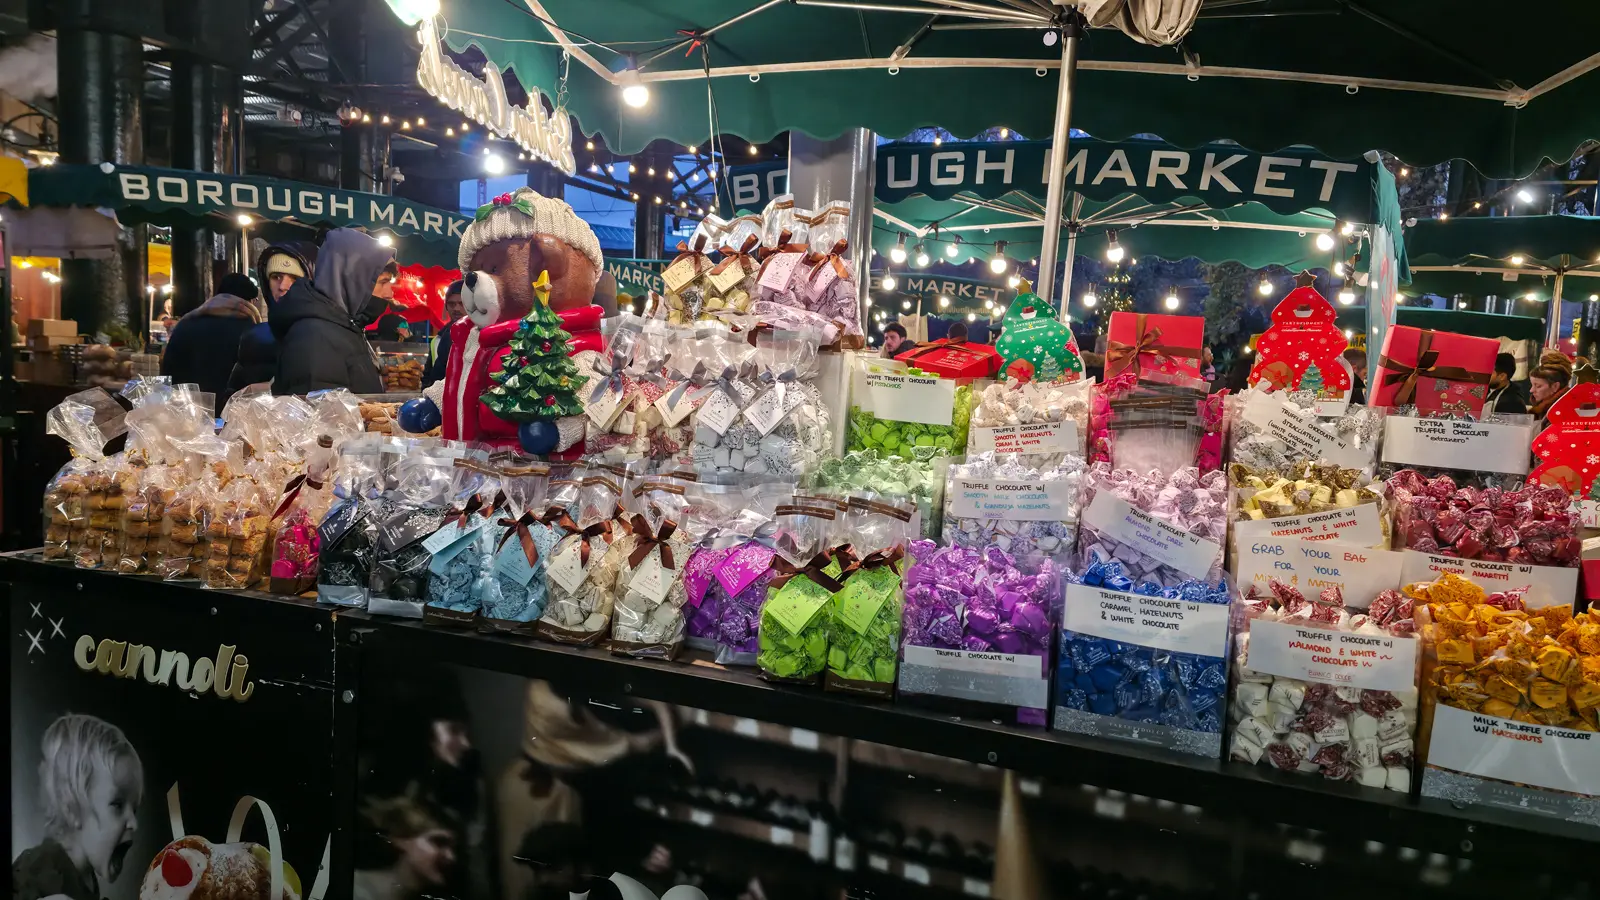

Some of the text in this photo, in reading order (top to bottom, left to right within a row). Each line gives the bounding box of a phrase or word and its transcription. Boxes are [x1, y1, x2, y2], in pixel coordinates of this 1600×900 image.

[1042, 148, 1359, 203] MARKET
[119, 173, 355, 219] BOROUGH
[609, 262, 665, 292] MARKE
[907, 278, 1005, 301] MARKET
[909, 377, 937, 385] CHOCOLATE
[1020, 424, 1049, 432] CHOCOLATE
[1281, 407, 1304, 424] TRUFFLE
[1307, 423, 1336, 442] CHOCOLATE
[1414, 426, 1490, 437] TRUFFLE CHOCOLATE
[1419, 420, 1444, 428] EXTRA
[1271, 430, 1319, 460] CHOCOLATE PIECES
[1288, 432, 1314, 450] CHOCOLATE
[962, 482, 989, 490] TRUFFLE
[963, 491, 989, 499] SMOOTH
[1129, 507, 1153, 524] TRUFFLE
[1157, 521, 1186, 539] CHOCOLATE
[1271, 519, 1301, 528] TRUFFLE
[1307, 511, 1342, 524] CHOCOLATE
[1124, 515, 1151, 533] ALMOND
[1166, 535, 1184, 548] DARK
[1271, 526, 1313, 537] HAZELNUTS
[1332, 520, 1358, 529] WHITE
[1135, 530, 1169, 550] CHOCOLATE
[1251, 543, 1368, 564] GRAB YOUR BAG
[1274, 561, 1341, 577] FOR YOUR
[1428, 556, 1465, 566] TRUFFLE
[1470, 561, 1513, 572] CHOCOLATE
[1100, 592, 1132, 603] TRUFFLE
[1139, 598, 1181, 610] CHOCOLATE
[1140, 608, 1184, 620] HAZELNUTS
[1110, 615, 1135, 624] WHITE
[1142, 619, 1180, 631] CHOCOLATE
[1296, 630, 1333, 641] TRUFFLE
[1340, 635, 1380, 646] CHOCOLATE
[935, 649, 962, 658] TRUFFLE
[968, 652, 1002, 662] CHOCOLATE
[1312, 655, 1358, 667] CHOCOLATE
[1350, 649, 1377, 658] WHITE
[74, 634, 254, 702] cannoli
[1473, 715, 1592, 741] MILK TRUFFLE CHOCOLATE
[1491, 728, 1543, 744] HAZELNUTS
